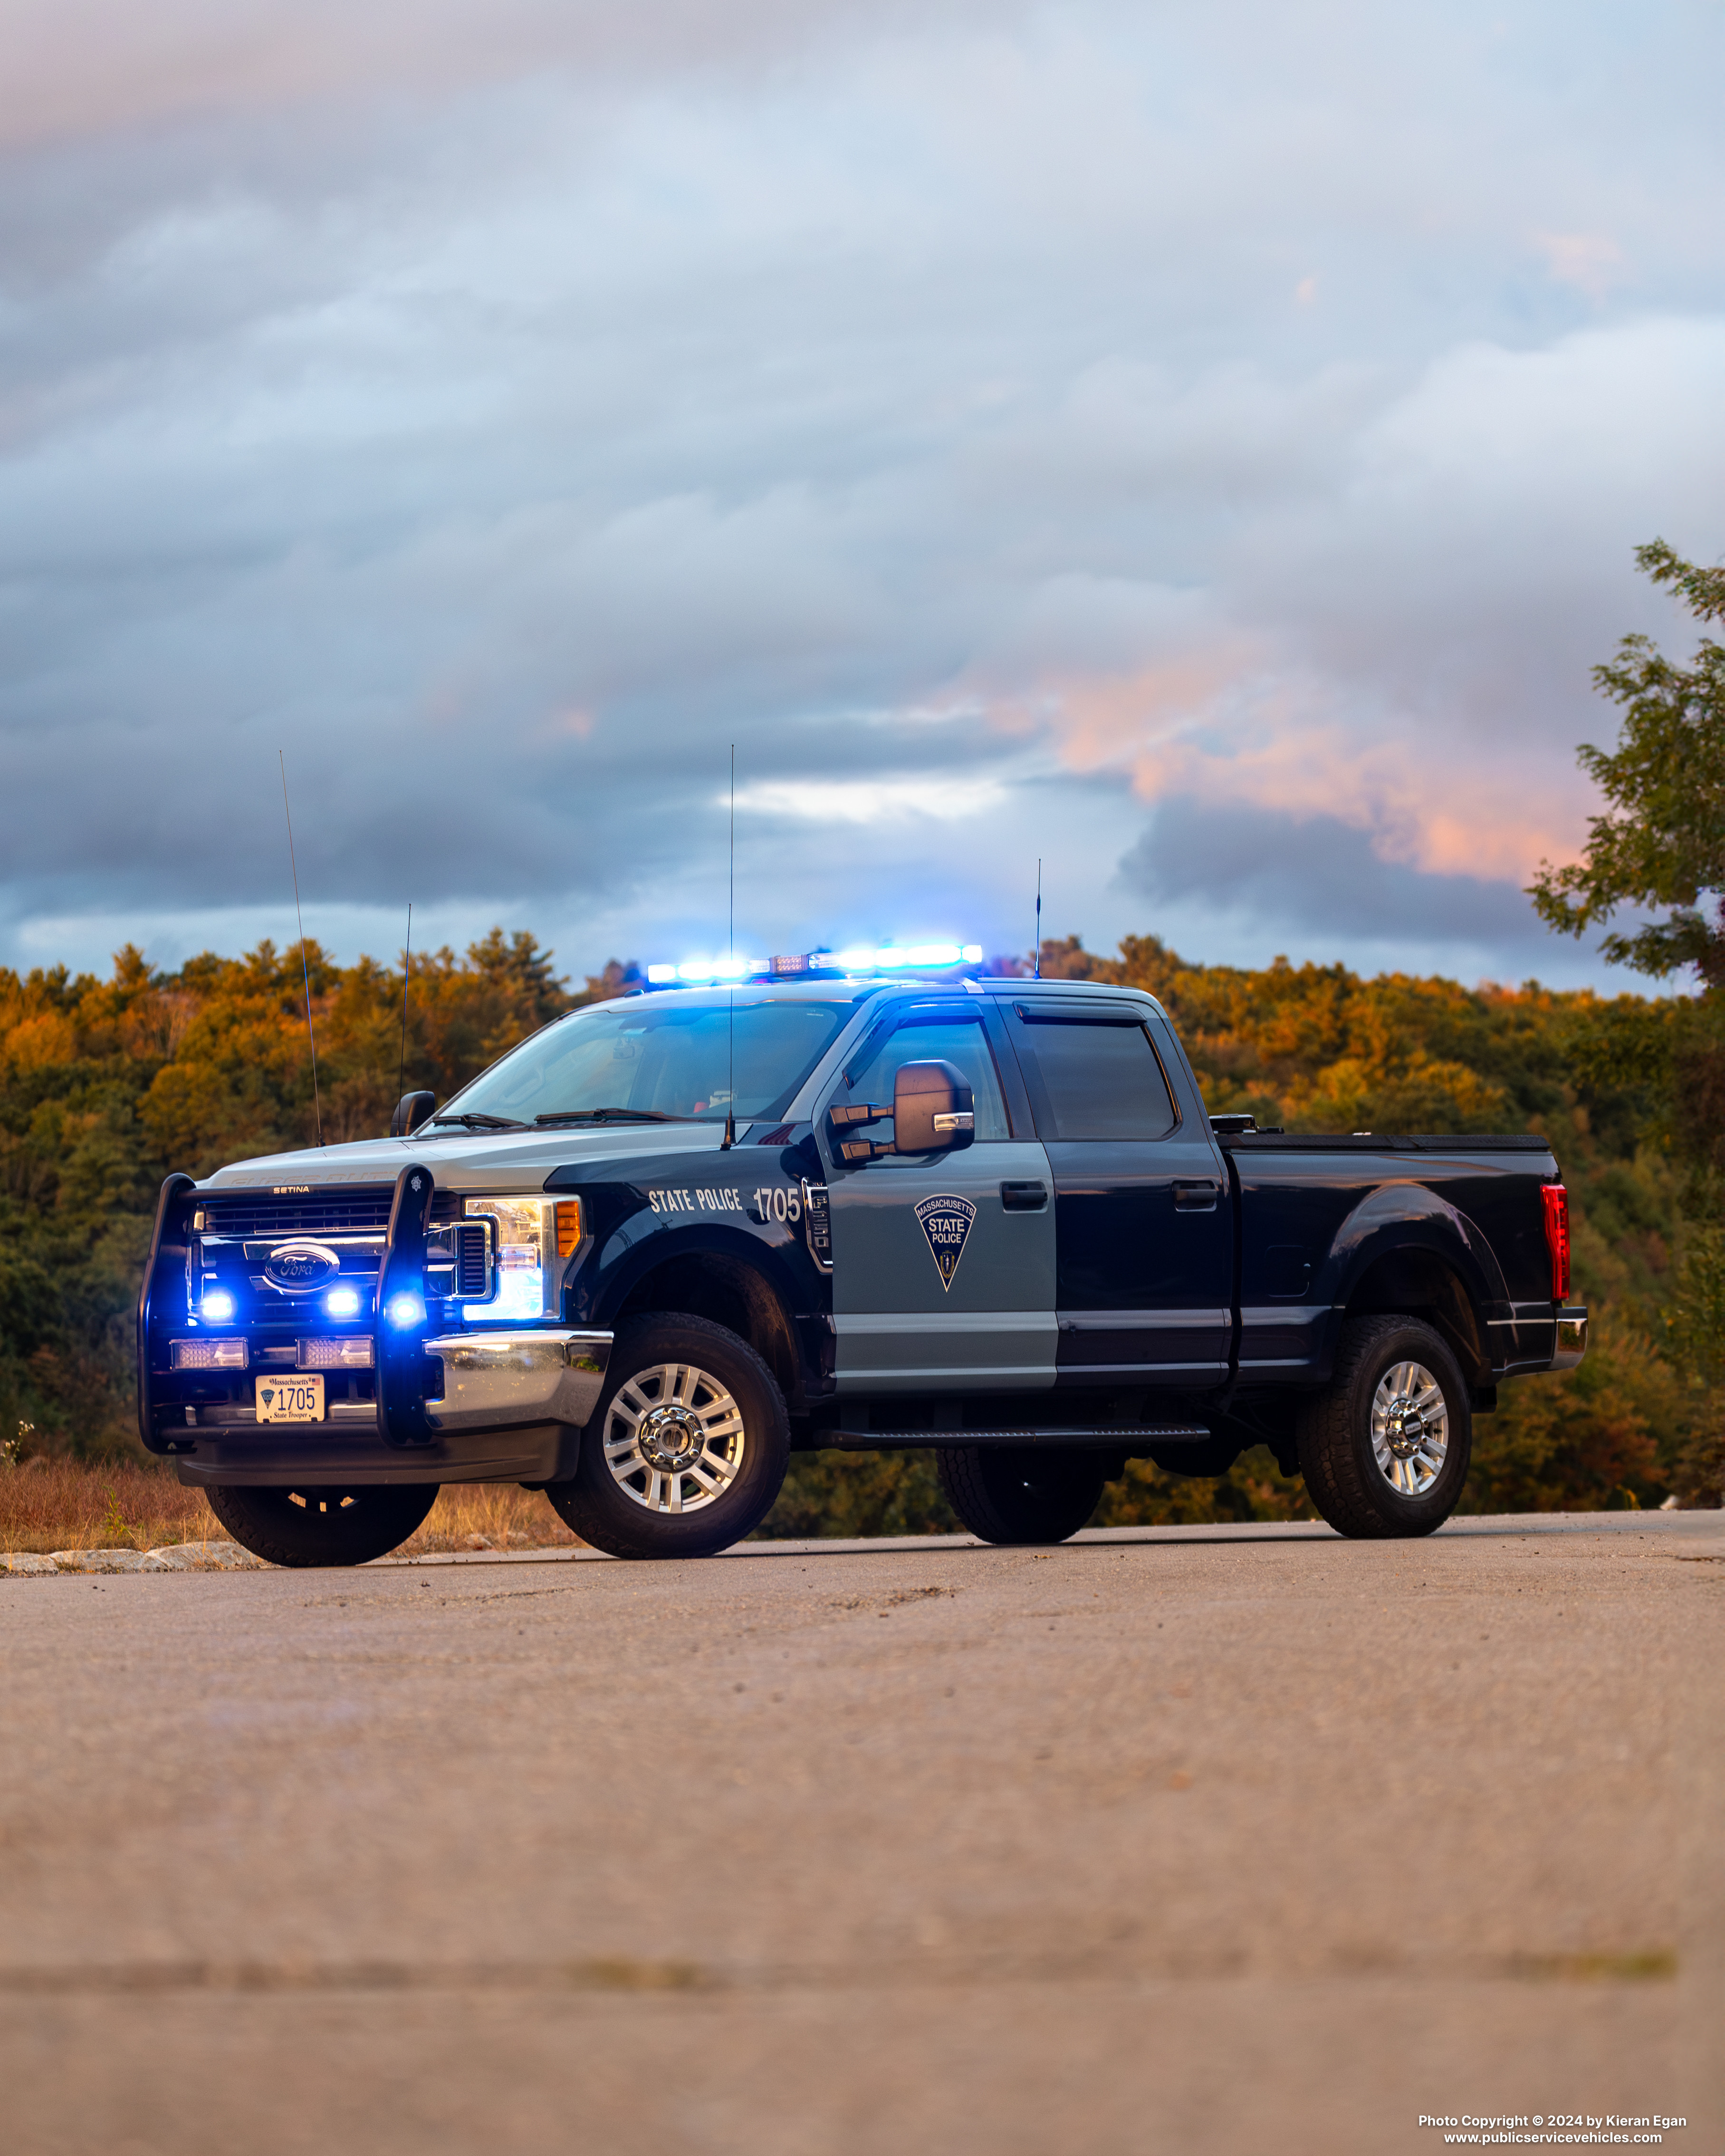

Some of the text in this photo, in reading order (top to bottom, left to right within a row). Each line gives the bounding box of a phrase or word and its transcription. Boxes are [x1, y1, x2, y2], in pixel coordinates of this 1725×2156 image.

[649, 1188, 800, 1222] STATE POLICE 1705
[917, 1199, 974, 1217] MASSACHUSETTS
[929, 1218, 965, 1232] STATE
[932, 1233, 961, 1244] POLICE
[280, 1256, 316, 1276] Ford
[278, 1388, 315, 1410] 1705
